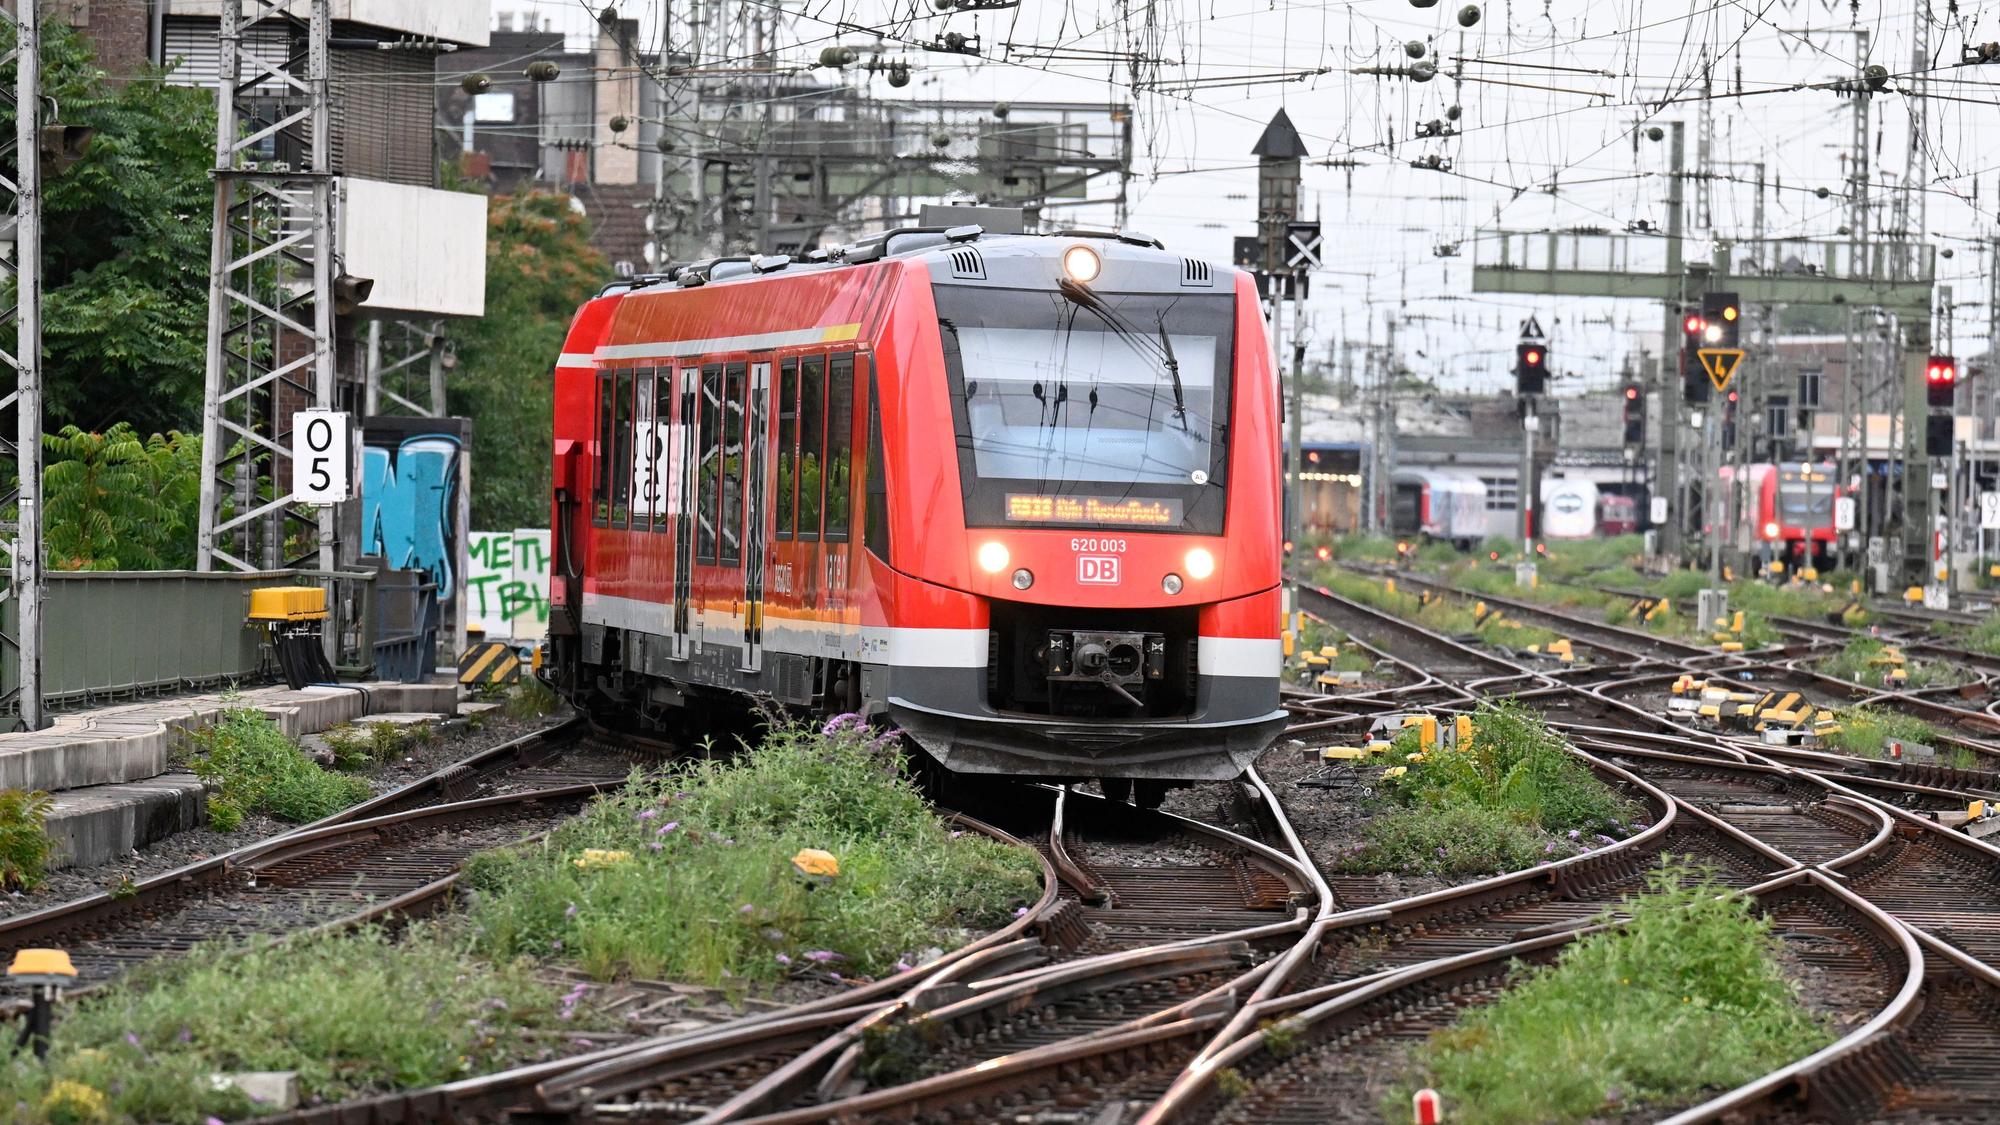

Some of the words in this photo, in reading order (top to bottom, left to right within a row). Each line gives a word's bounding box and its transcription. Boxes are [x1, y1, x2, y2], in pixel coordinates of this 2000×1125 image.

[307, 418, 332, 452] 0
[309, 458, 330, 491] 5
[1071, 538, 1097, 551] 620
[1100, 538, 1126, 552] 003
[1082, 558, 1116, 580] DB
